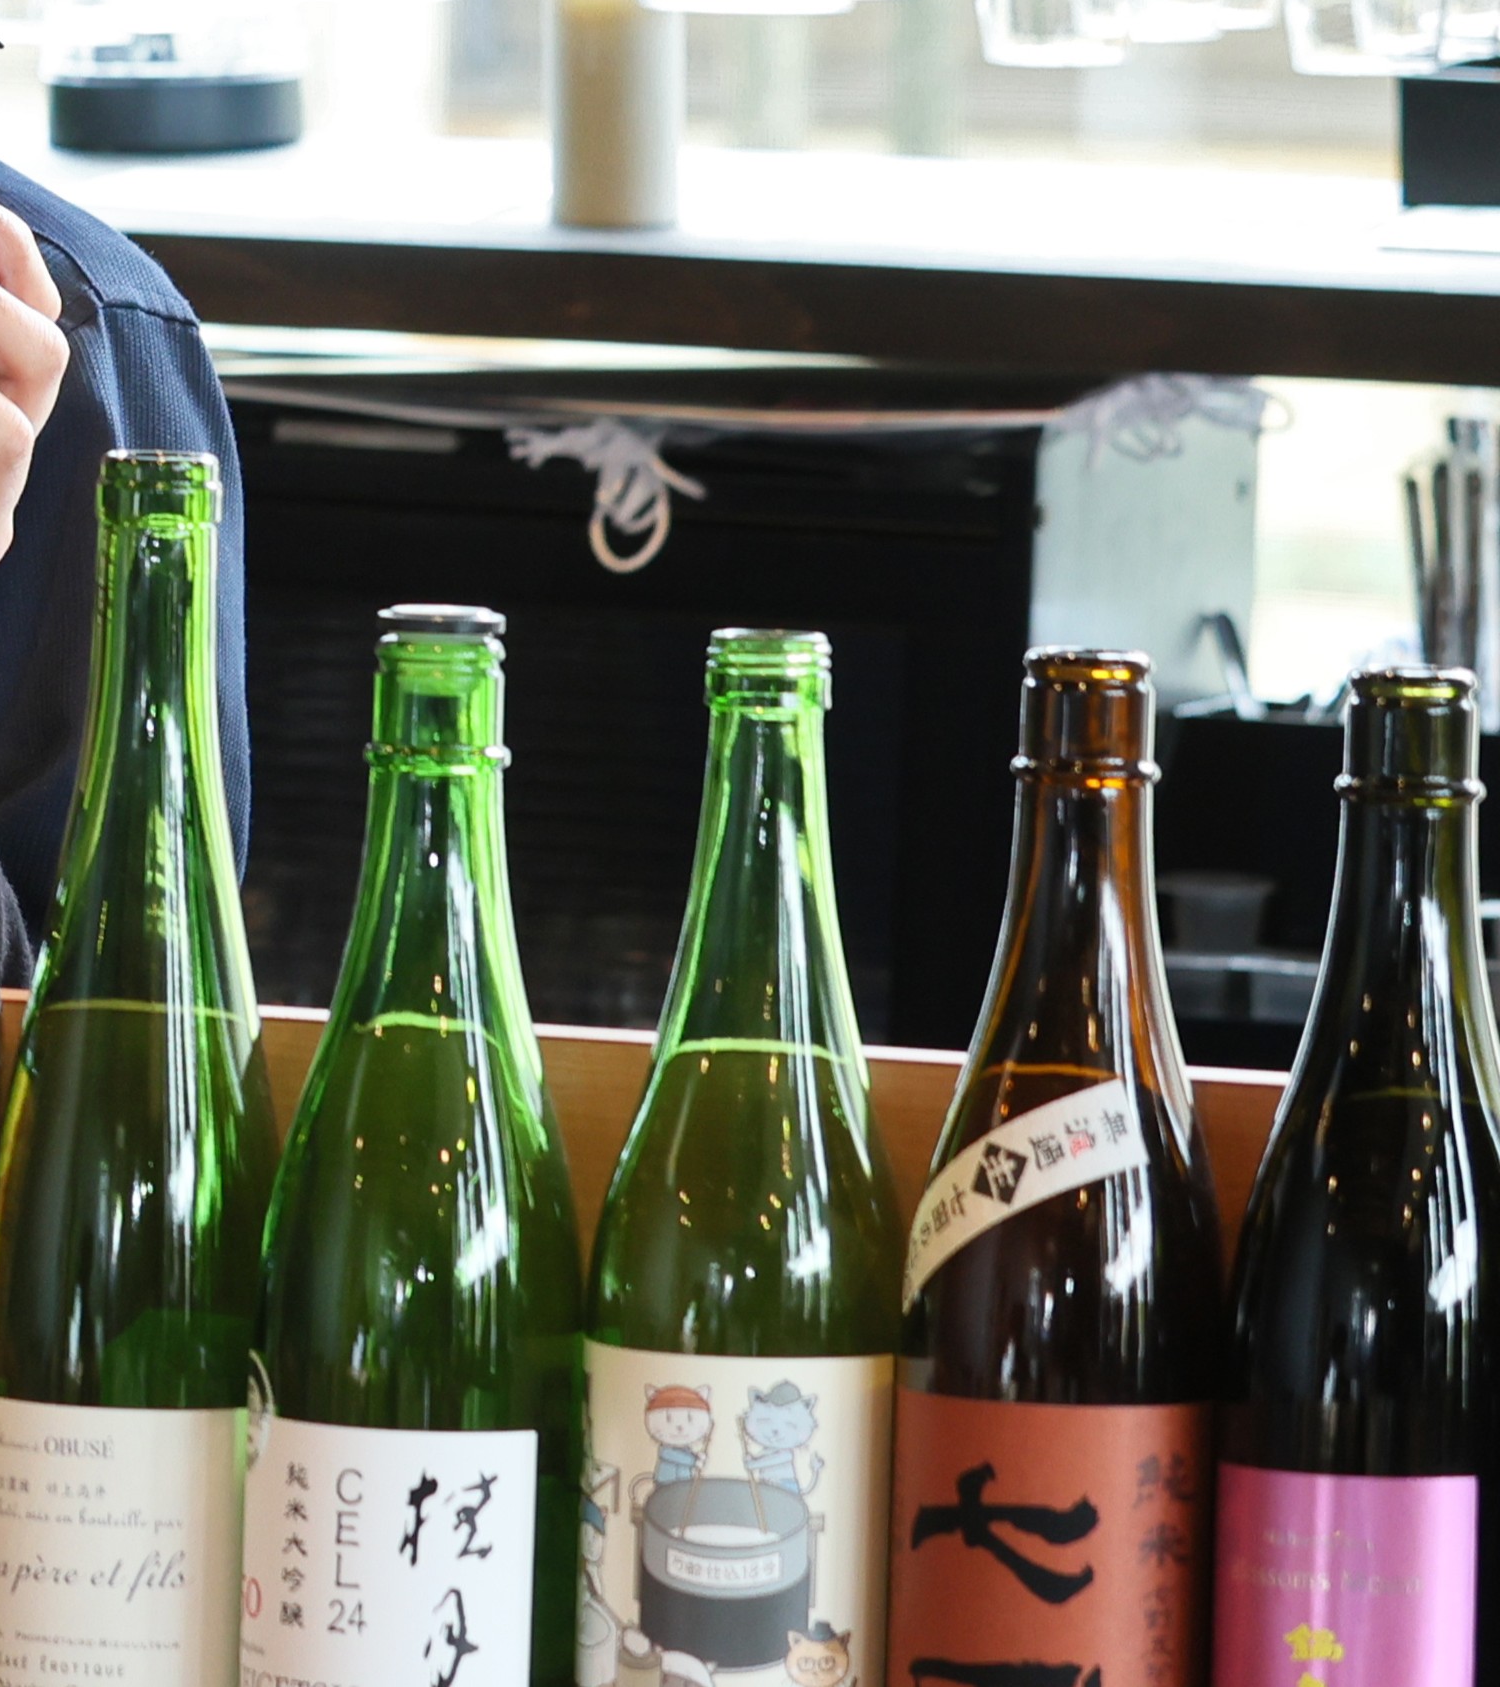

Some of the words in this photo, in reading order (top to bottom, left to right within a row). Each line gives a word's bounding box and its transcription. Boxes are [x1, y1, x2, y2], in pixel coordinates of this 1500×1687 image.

[10, 1554, 78, 1596] père
[89, 1558, 123, 1587] et
[125, 1549, 186, 1604] fils
[279, 1461, 310, 1630] 純米大吟醸
